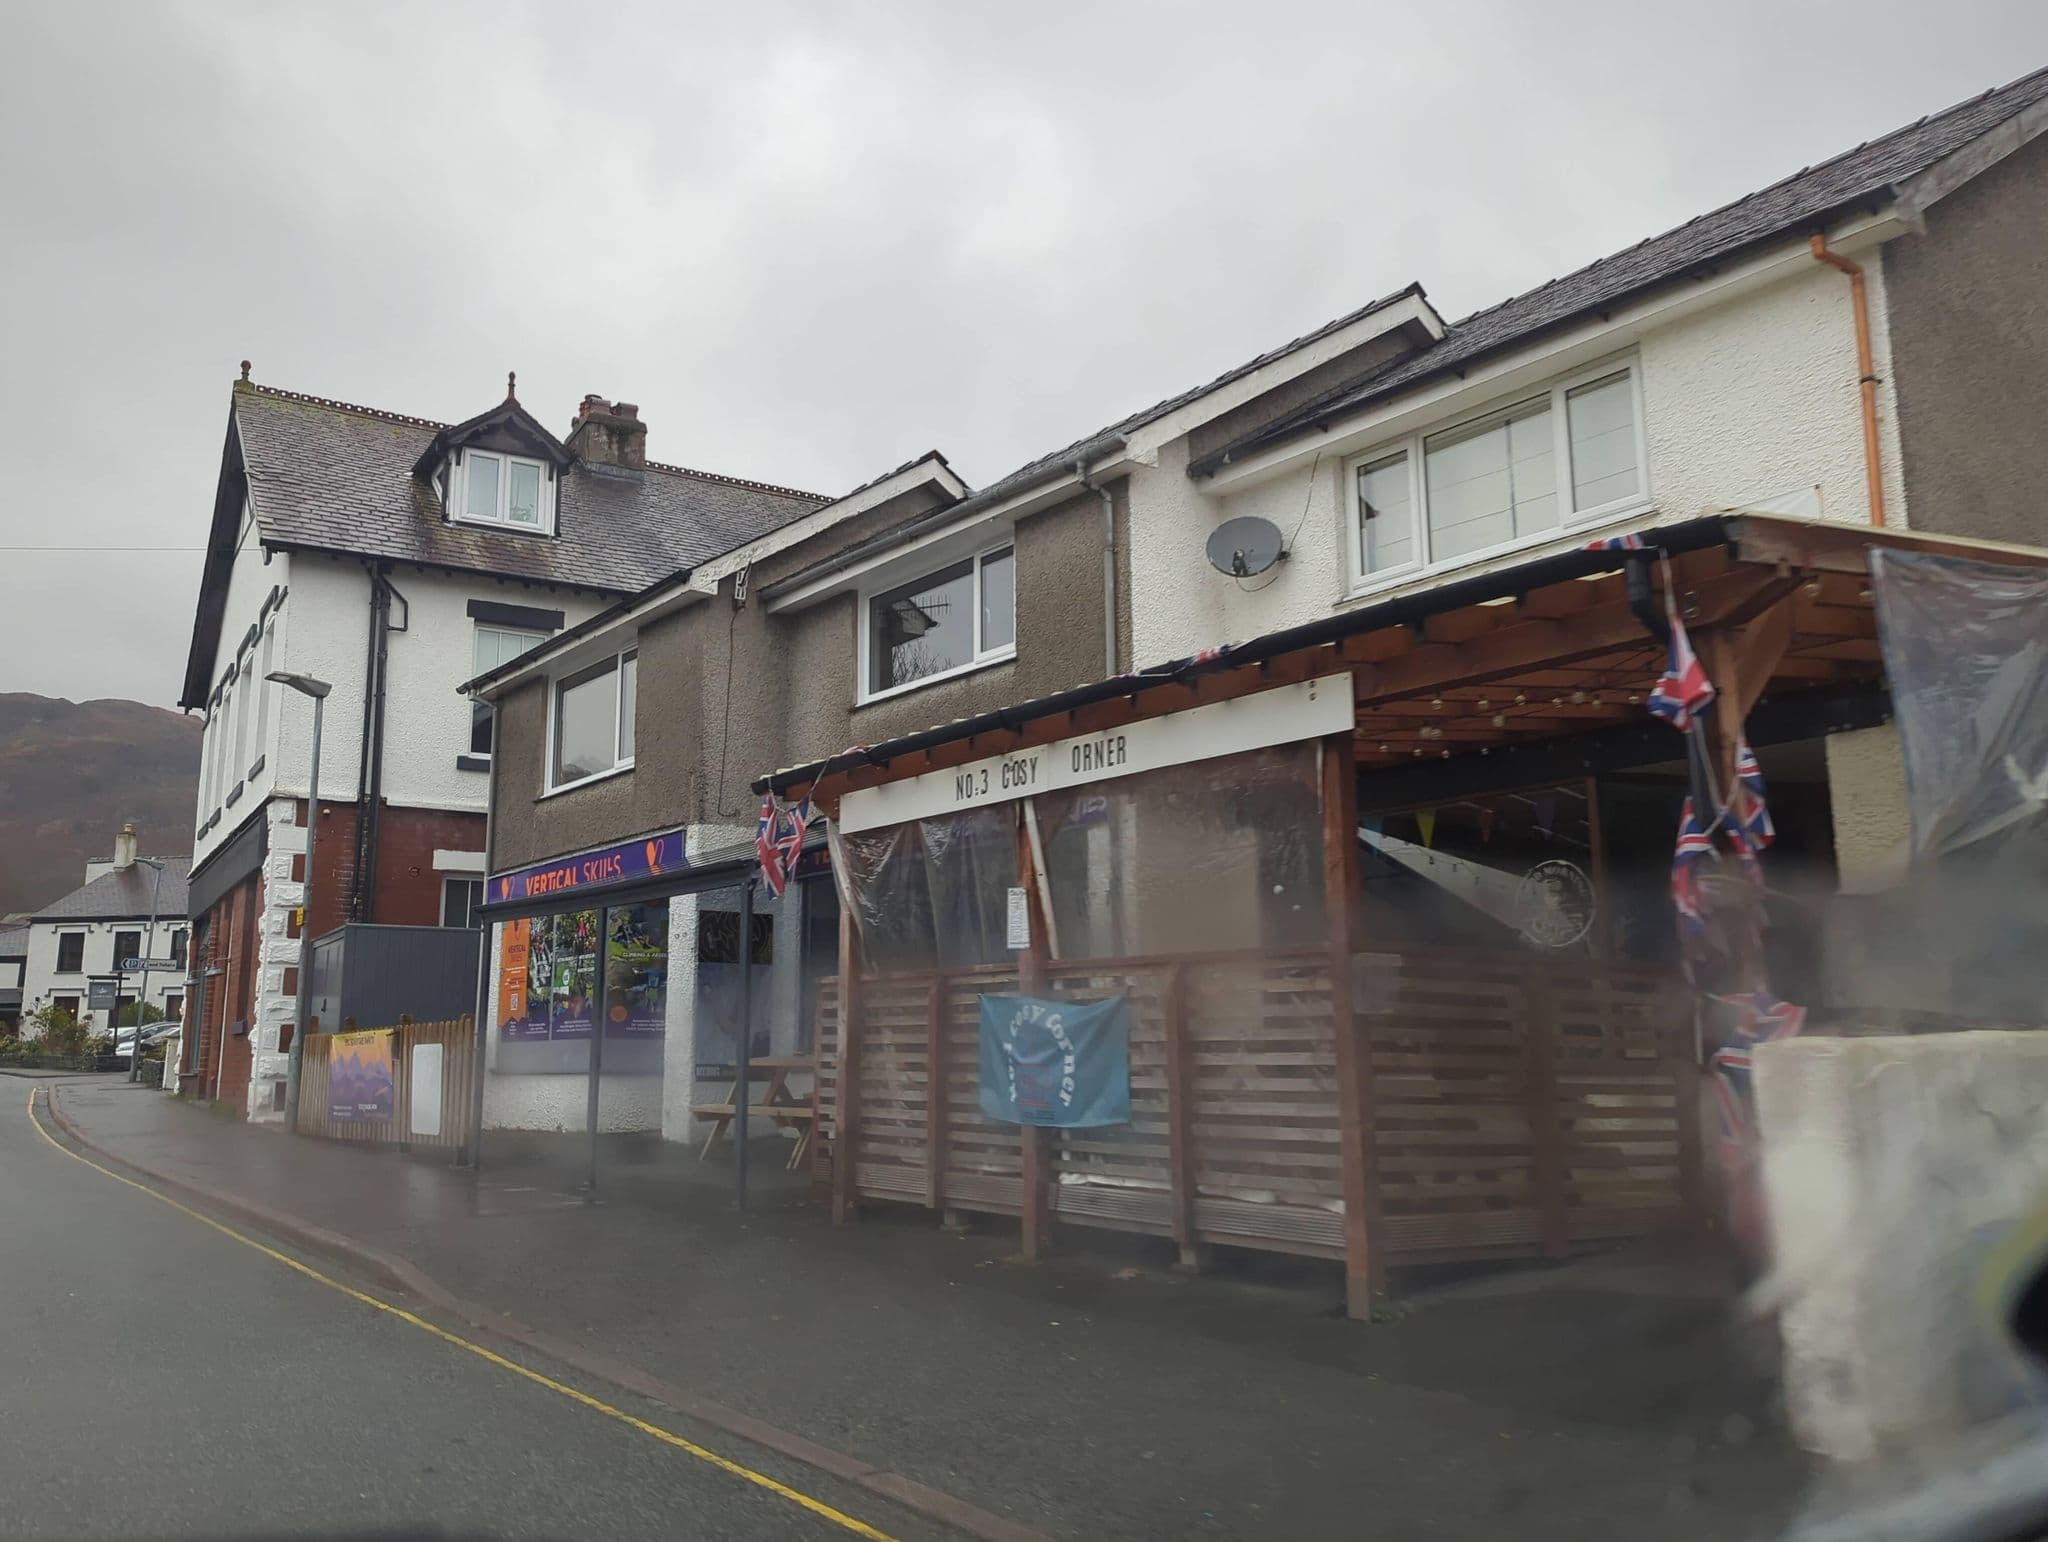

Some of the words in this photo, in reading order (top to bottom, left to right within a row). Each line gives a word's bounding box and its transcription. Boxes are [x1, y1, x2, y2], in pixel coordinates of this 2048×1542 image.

[1002, 756, 1039, 789] COSY
[1072, 735, 1127, 773] ORNER
[526, 866, 579, 896] VERTICAL
